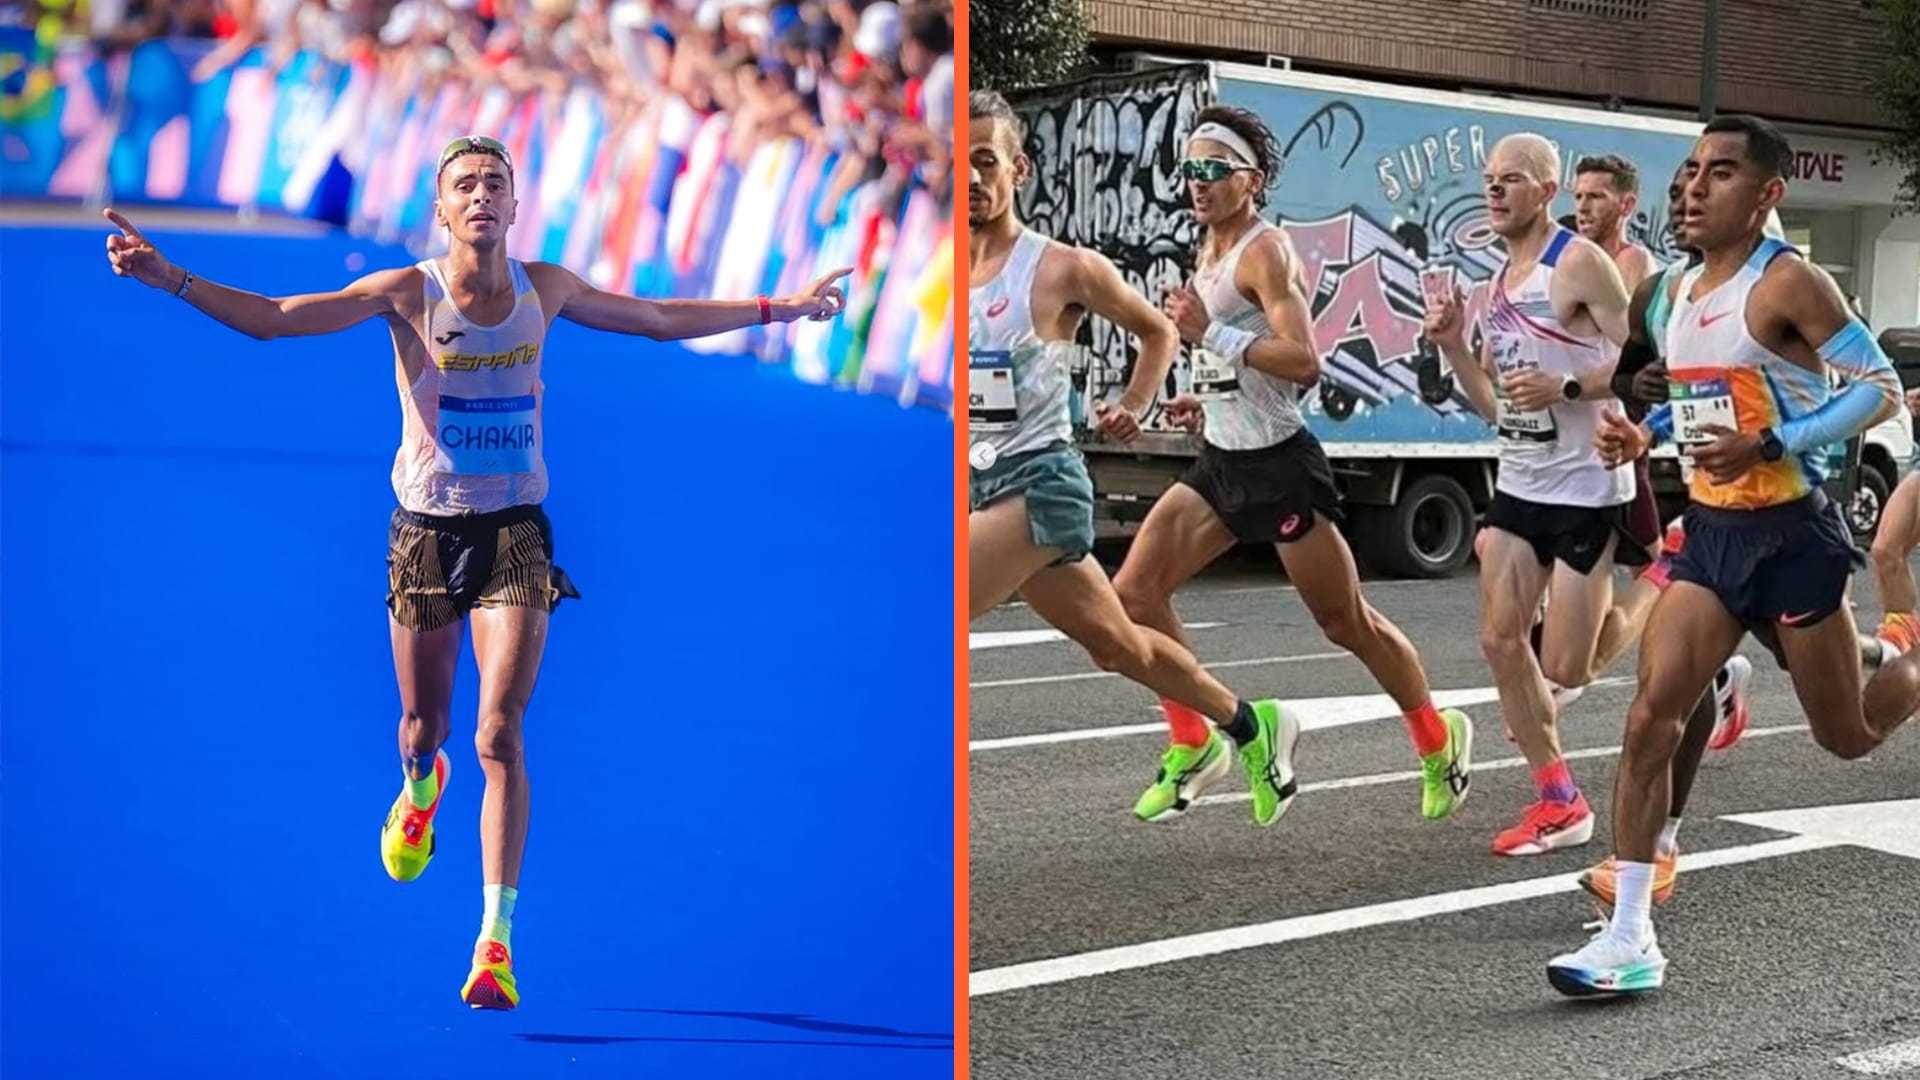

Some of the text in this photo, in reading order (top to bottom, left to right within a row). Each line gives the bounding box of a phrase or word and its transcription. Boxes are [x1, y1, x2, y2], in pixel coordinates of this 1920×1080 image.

[1377, 124, 1487, 201] SUPER
[438, 343, 539, 371] ESPAÑA
[441, 424, 536, 450] CHAKIR
